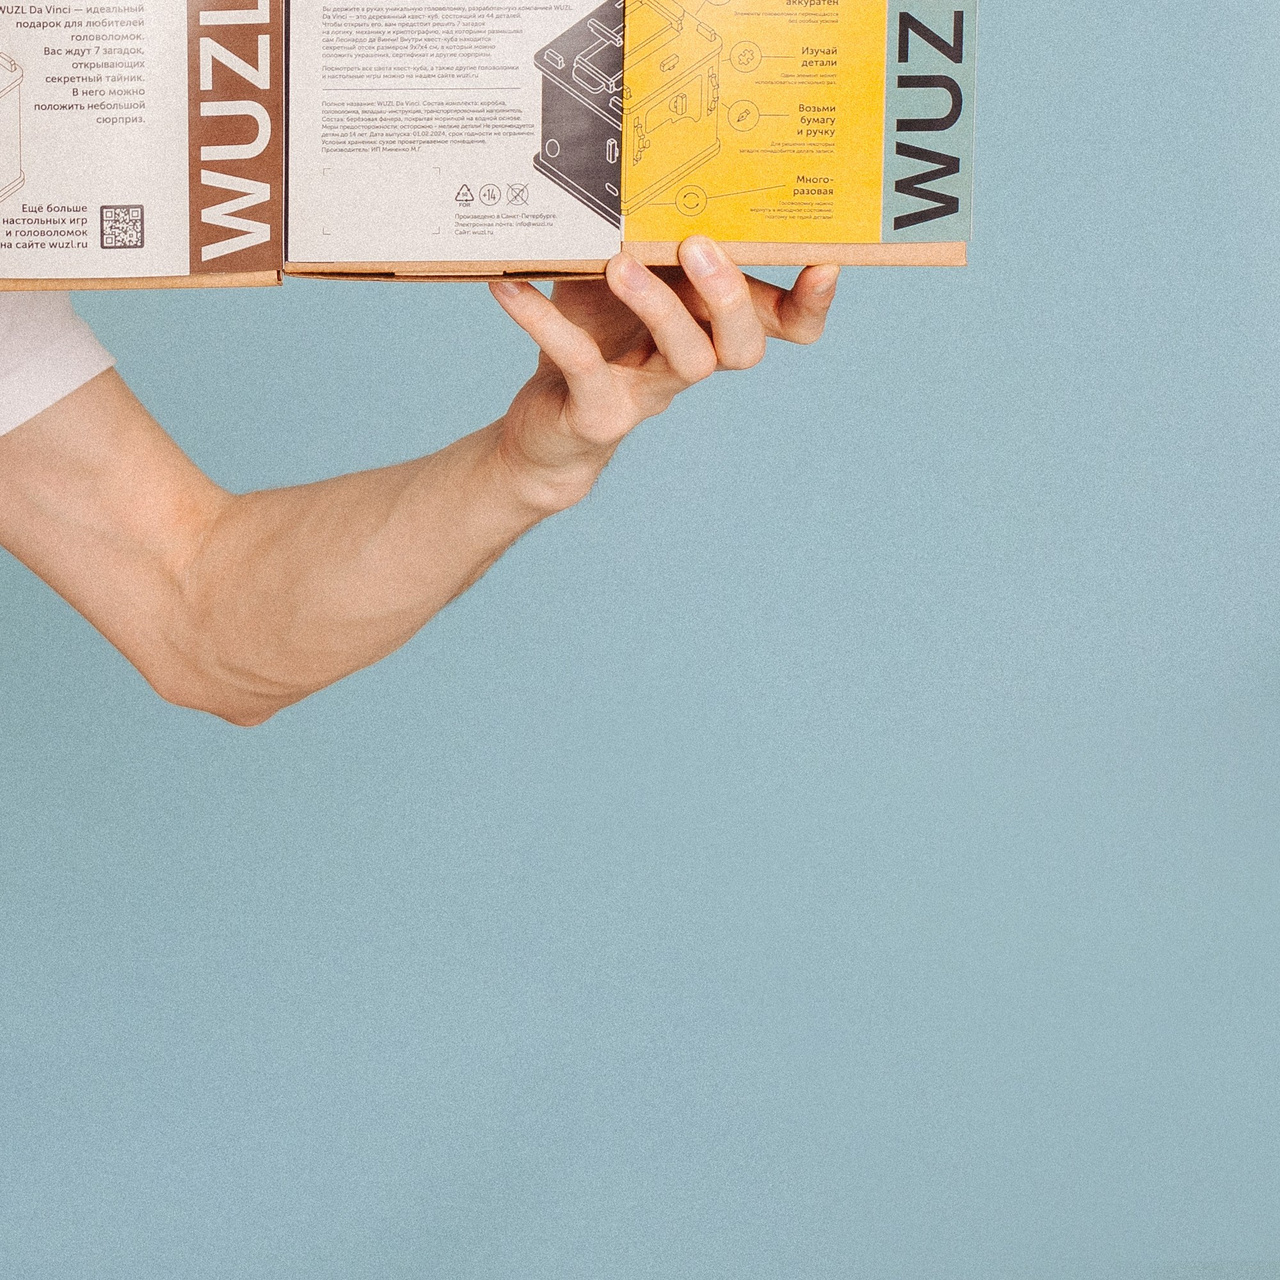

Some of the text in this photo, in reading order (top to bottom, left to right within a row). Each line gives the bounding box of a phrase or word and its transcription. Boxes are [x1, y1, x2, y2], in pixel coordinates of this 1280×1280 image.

[29, 4, 42, 14] Da
[45, 4, 70, 13] Vinci
[86, 3, 145, 14] идеальный
[786, 0, 839, 7] аккуратен
[16, 16, 145, 29] подарок для любителей
[44, 45, 145, 57] Вас ждут 7 загадок,
[802, 46, 838, 57] Изучай
[72, 61, 145, 70] открывающих
[46, 72, 145, 84] секретный тайник.
[72, 86, 78, 96] В
[87, 100, 146, 109] небольшой
[798, 104, 836, 112] Возьми
[96, 116, 146, 126] сюрприз.
[800, 116, 836, 126] бумагу
[806, 129, 836, 138] ручку
[796, 176, 834, 184] Много-
[793, 188, 834, 196] разовая
[22, 202, 88, 214] Ещё больше
[69, 218, 88, 227] игр
[15, 239, 45, 249] сайте
[49, 239, 88, 249] wuzl.ru
